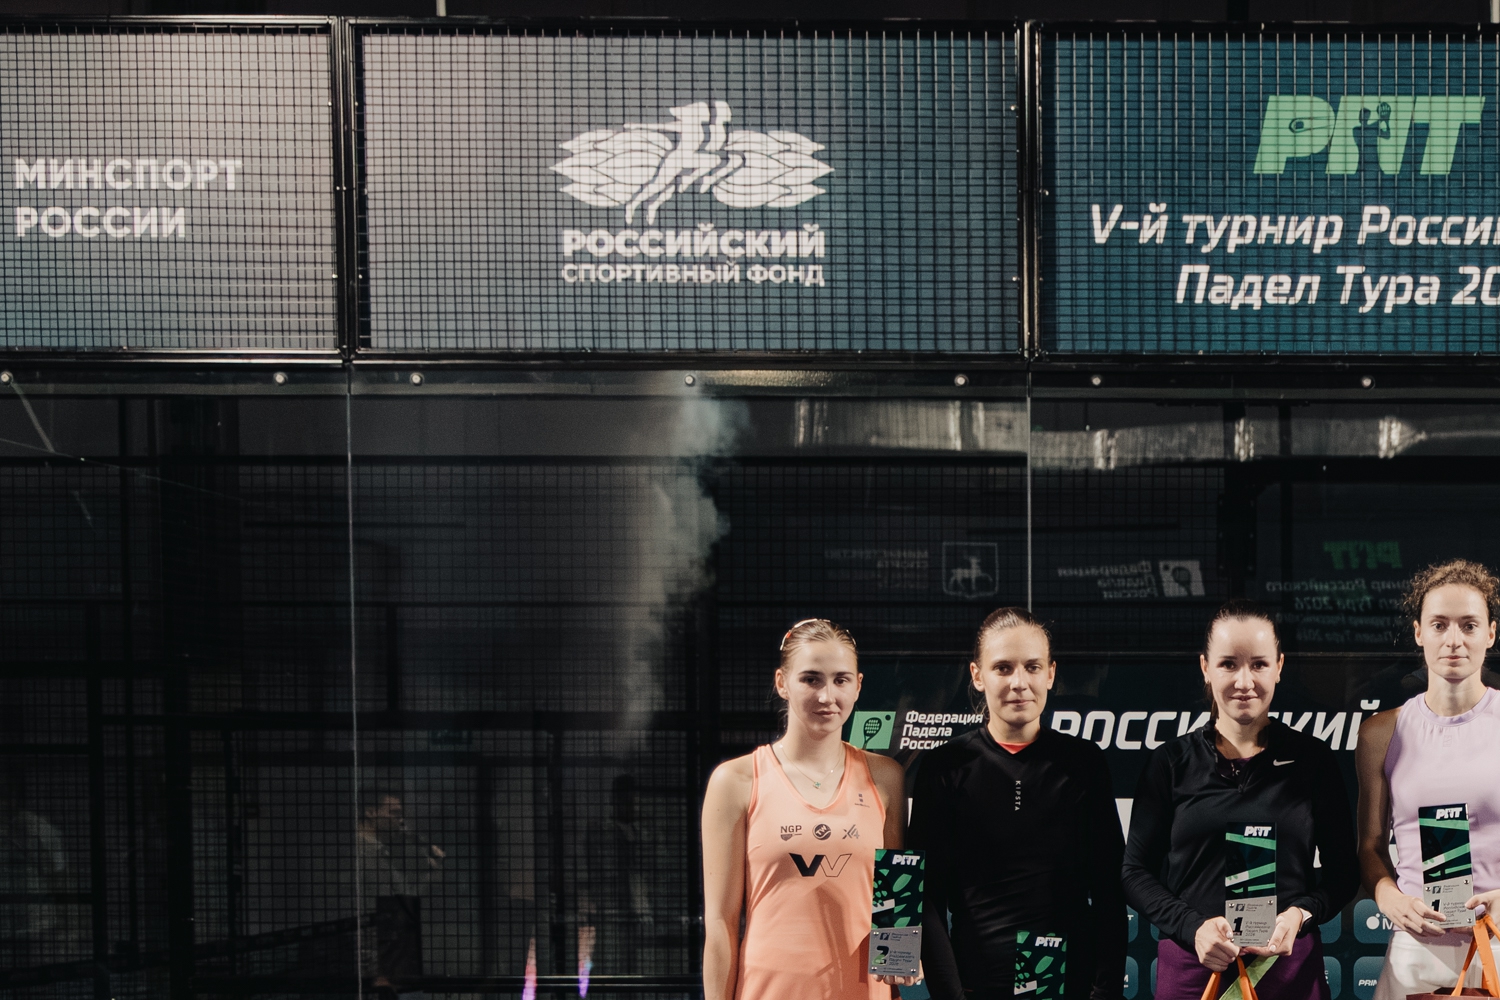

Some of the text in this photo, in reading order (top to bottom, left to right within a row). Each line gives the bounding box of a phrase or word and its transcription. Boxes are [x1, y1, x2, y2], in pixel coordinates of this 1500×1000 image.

[14, 158, 241, 191] МИНСПОРТ
[15, 206, 186, 238] РОССИИ
[1091, 203, 1167, 245] V-й
[1184, 212, 1343, 253] турнир
[563, 224, 825, 258] РОССИЙСКИЙ
[562, 259, 825, 286] СПОРТИВНЫЙ ФОНД
[1176, 265, 1320, 310] Падел
[1337, 265, 1440, 313] Тура
[902, 724, 953, 738] Падела
[905, 711, 983, 725] Федерация
[1014, 780, 1022, 811] KIPSTA
[780, 825, 802, 833] NGP
[1233, 917, 1244, 936] 1
[872, 945, 890, 965] 2
